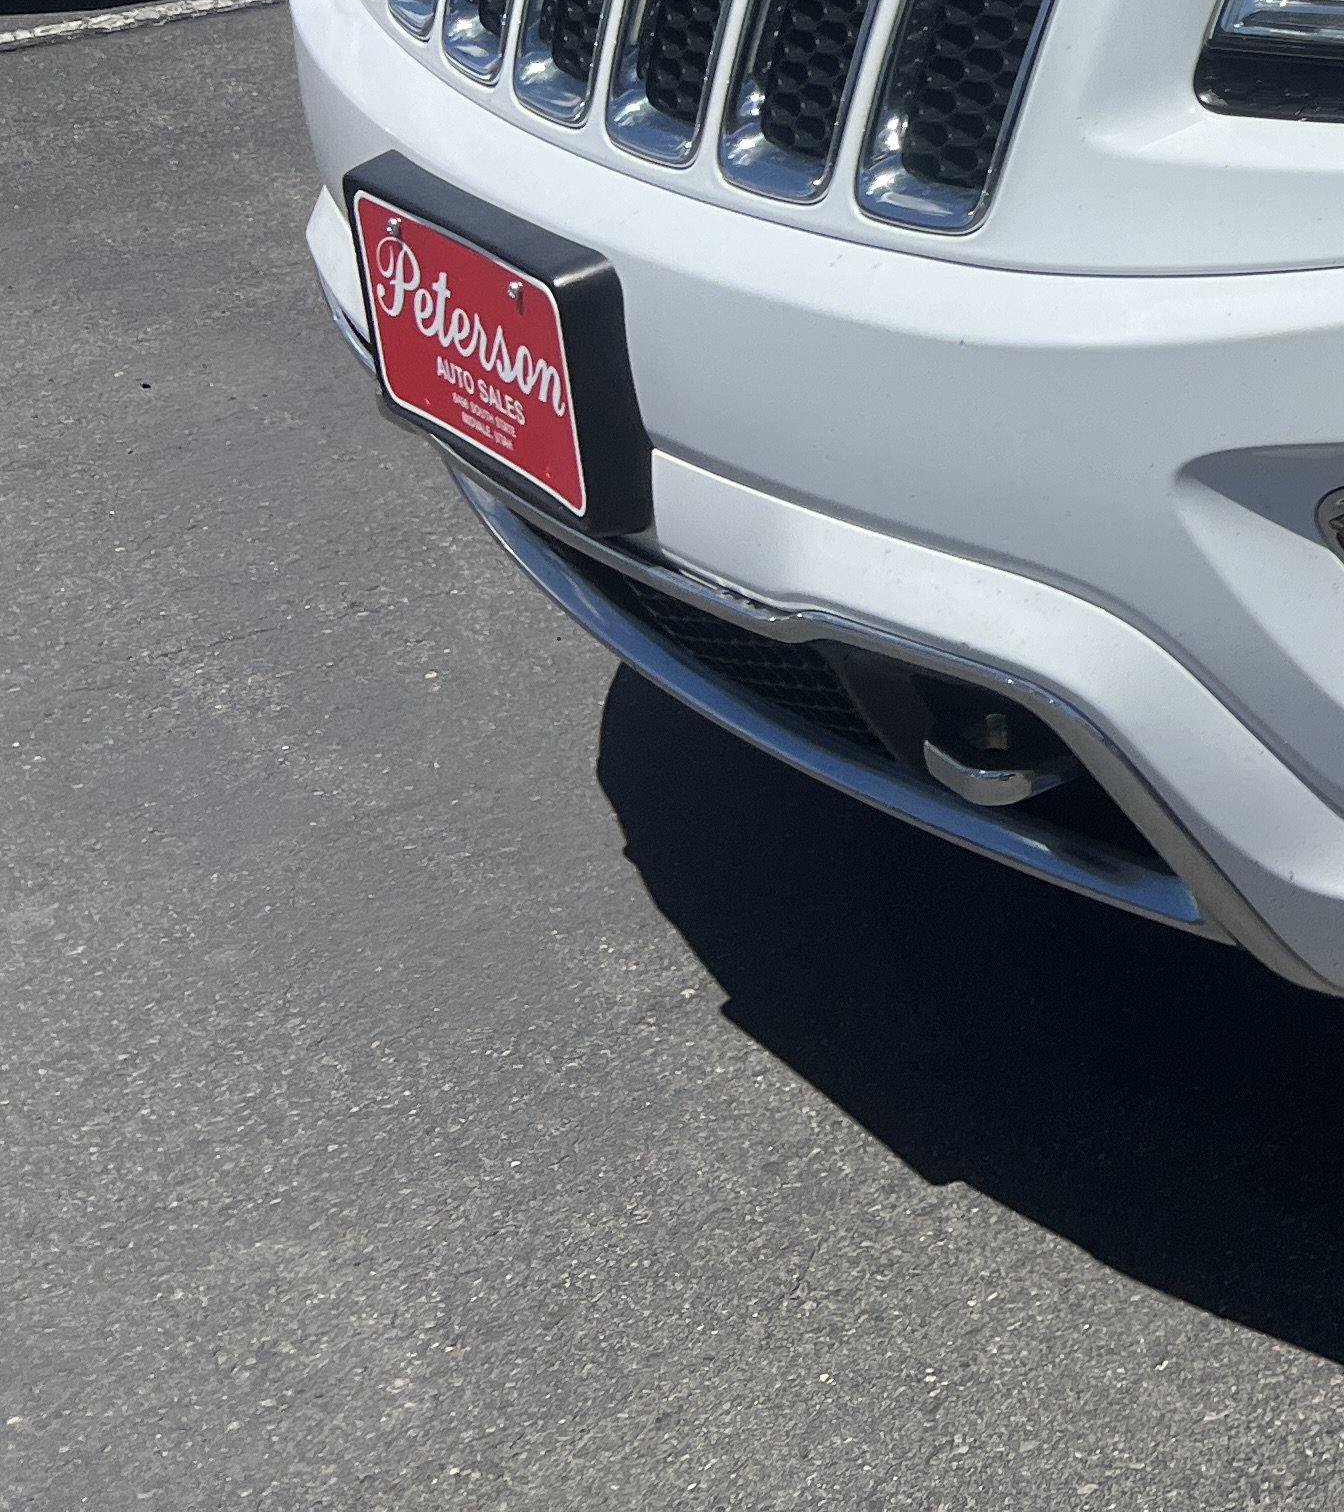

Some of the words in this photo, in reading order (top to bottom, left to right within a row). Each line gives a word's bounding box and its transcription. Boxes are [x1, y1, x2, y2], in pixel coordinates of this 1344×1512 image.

[376, 236, 566, 417] Peterson
[436, 355, 475, 395] AUTO
[477, 378, 526, 426] SALES
